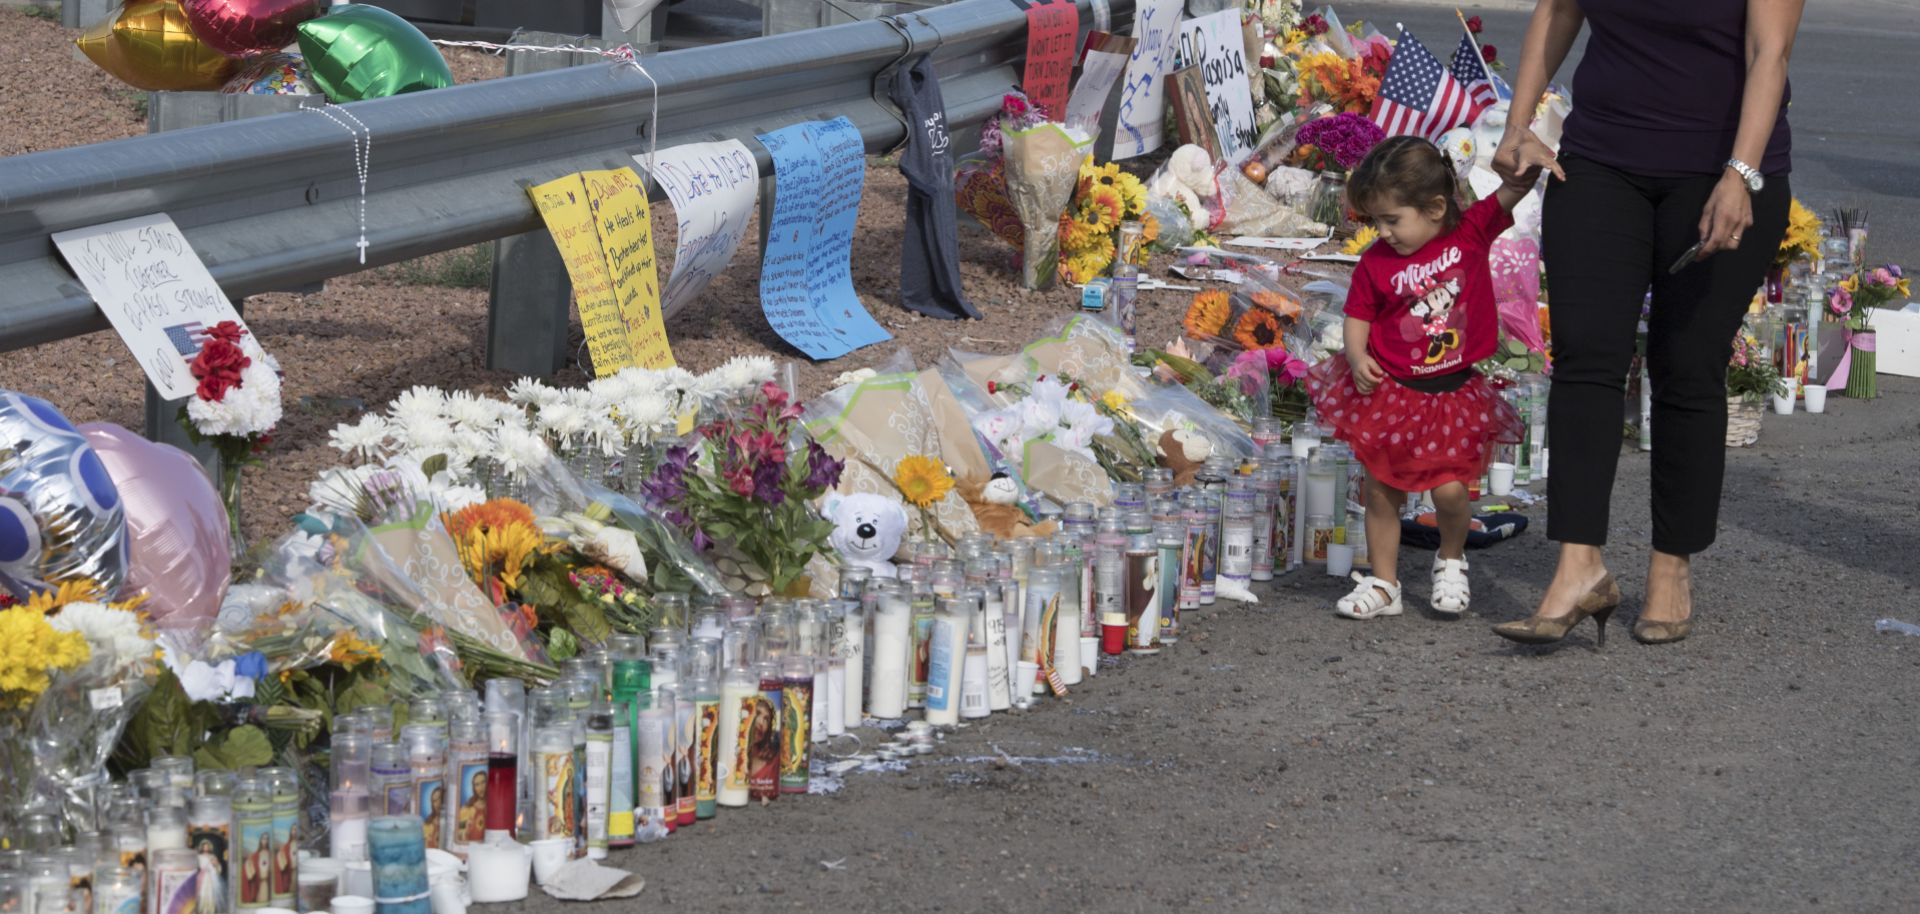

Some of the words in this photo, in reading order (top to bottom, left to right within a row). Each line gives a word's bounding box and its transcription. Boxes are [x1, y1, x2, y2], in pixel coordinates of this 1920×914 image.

[604, 218, 615, 236] He
[616, 209, 635, 229] Heals
[635, 206, 645, 221] the
[76, 239, 107, 284] WE
[138, 226, 182, 257] STAND
[1390, 246, 1462, 295] Minnie
[1410, 354, 1463, 375] Disneyland
